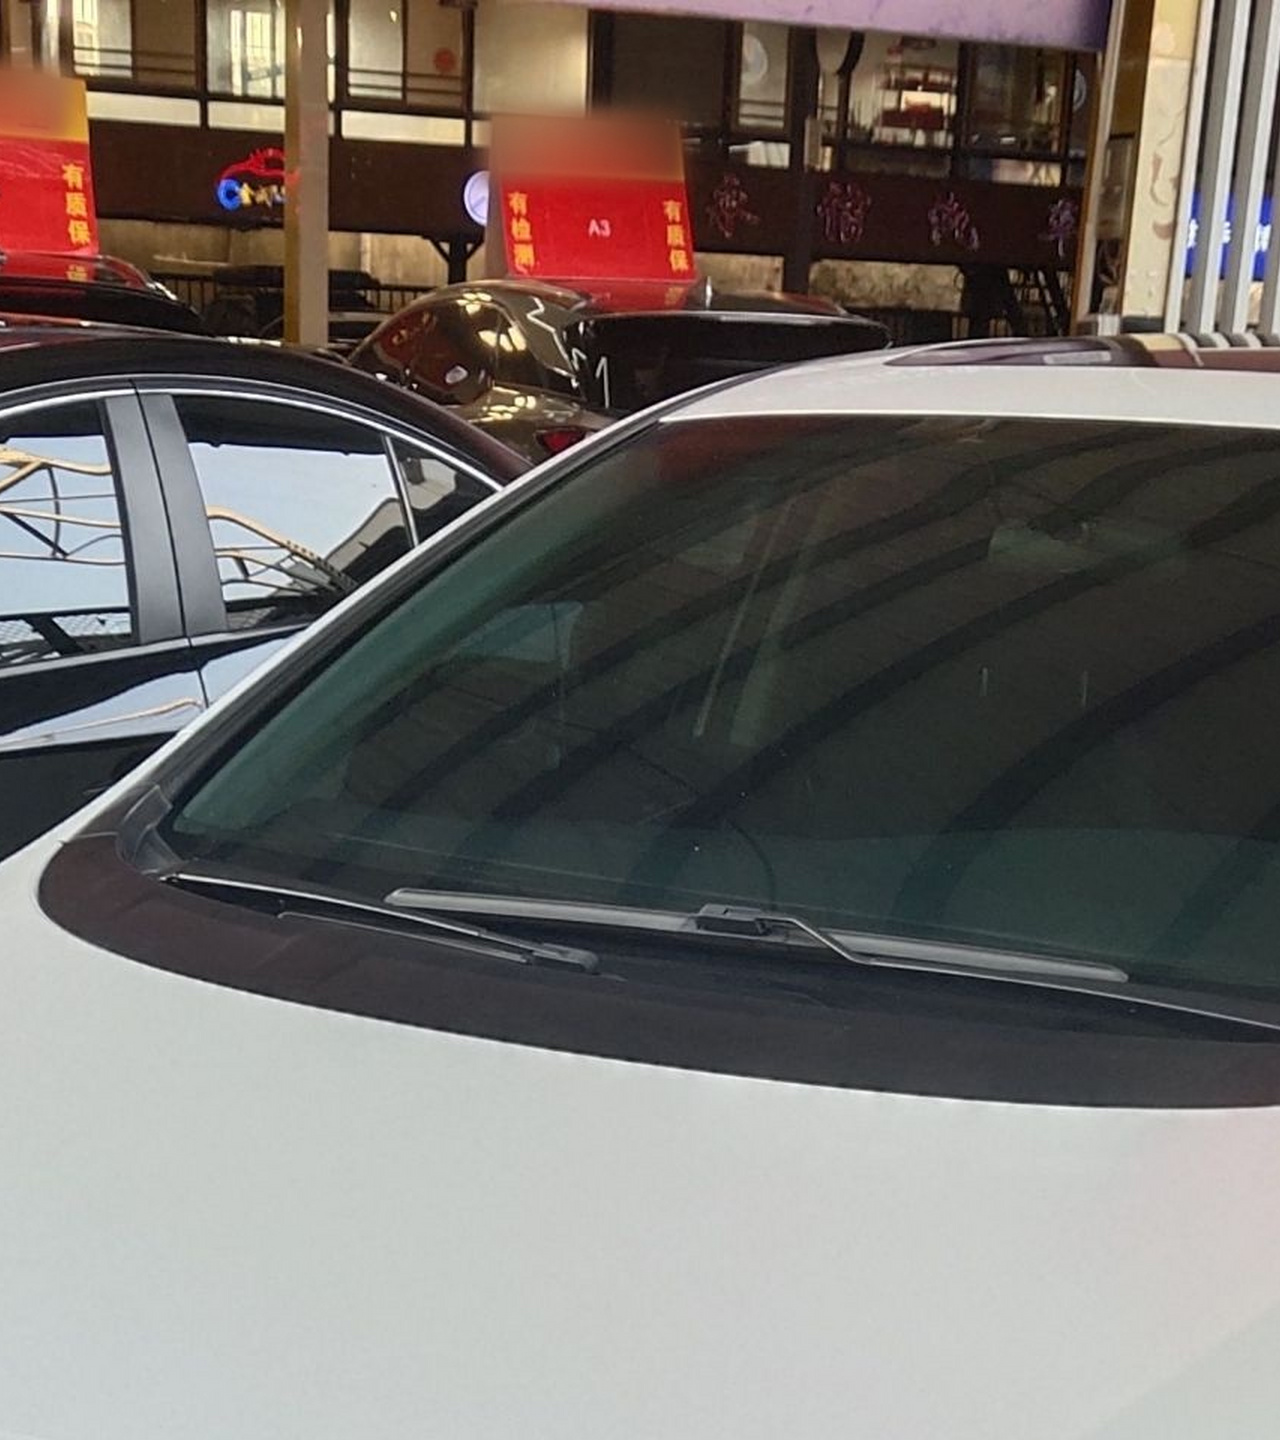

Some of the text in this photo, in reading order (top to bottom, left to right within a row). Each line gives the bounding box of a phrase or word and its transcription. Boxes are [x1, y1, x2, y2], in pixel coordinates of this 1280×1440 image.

[62, 162, 91, 246] 有质保
[508, 191, 536, 269] 有检测
[587, 218, 612, 238] A3
[662, 199, 690, 273] 有质保
